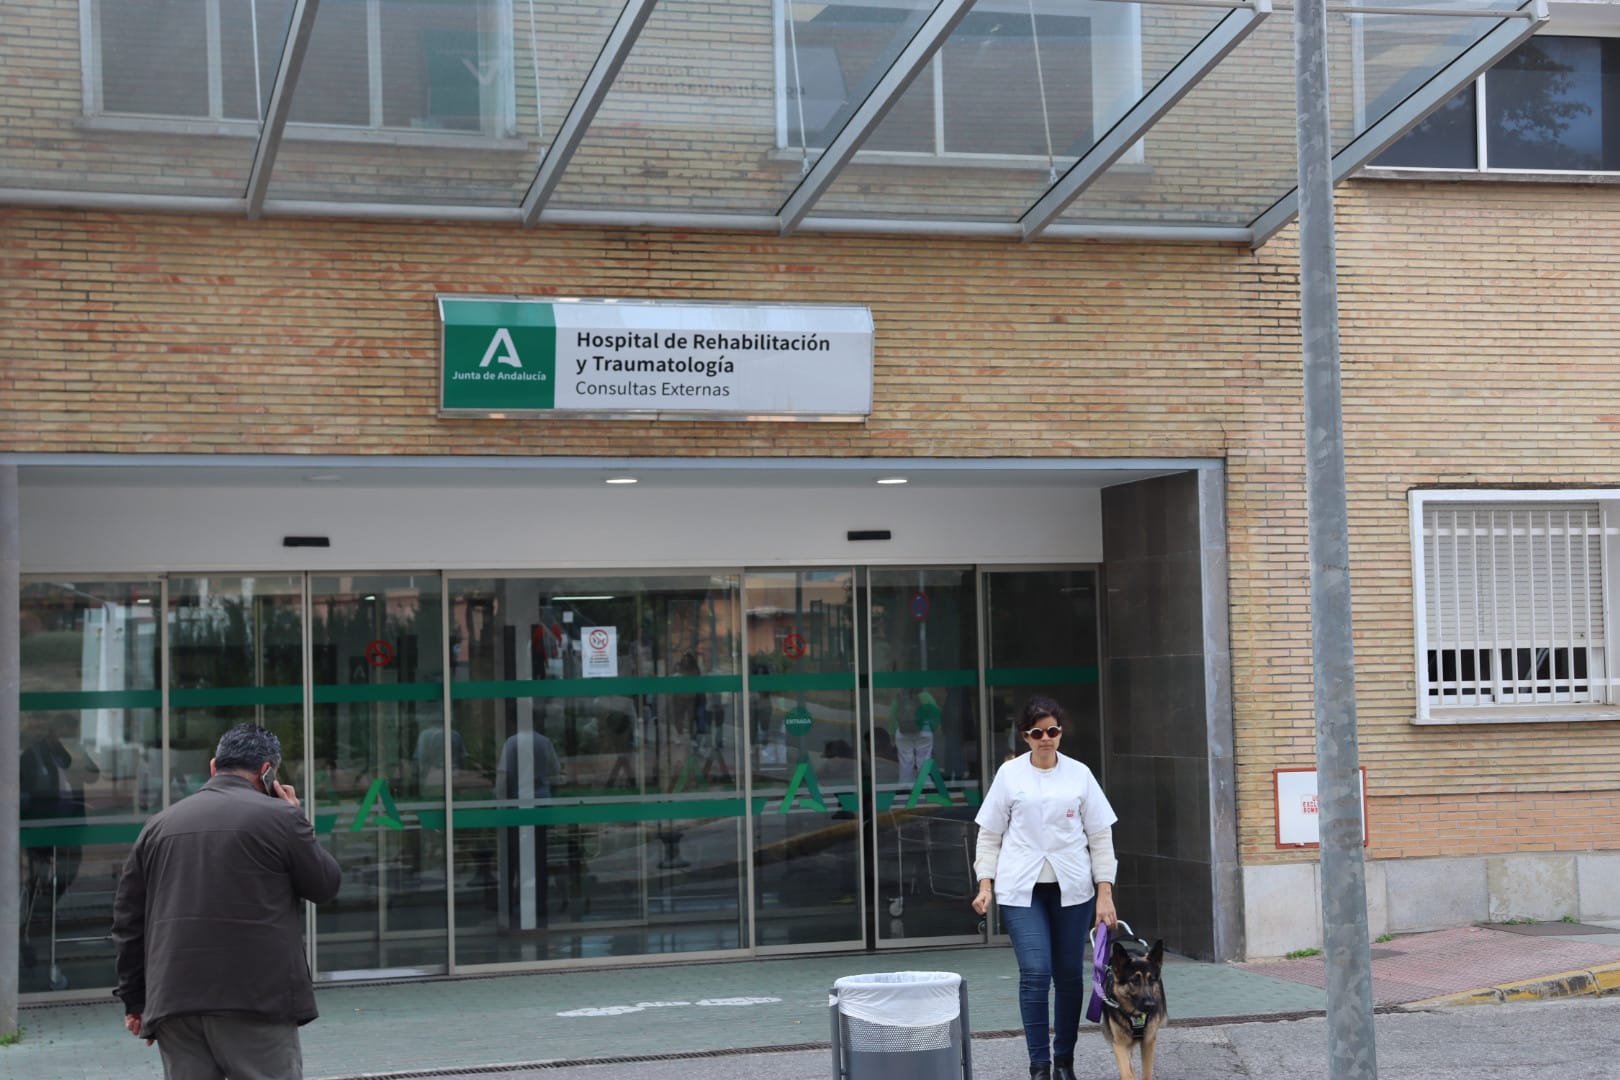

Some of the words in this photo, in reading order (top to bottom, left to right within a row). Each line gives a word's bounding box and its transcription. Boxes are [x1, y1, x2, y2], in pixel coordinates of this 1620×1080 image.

[577, 332, 659, 352] Hospital
[664, 333, 688, 349] de
[693, 333, 830, 351] Rehabilitación
[576, 359, 587, 375] y
[592, 355, 734, 377] Traumatología
[452, 371, 481, 380] Junta
[483, 371, 496, 380] de
[497, 371, 546, 381] Andalucía
[575, 381, 657, 396] Consultas
[662, 382, 730, 397] Externas
